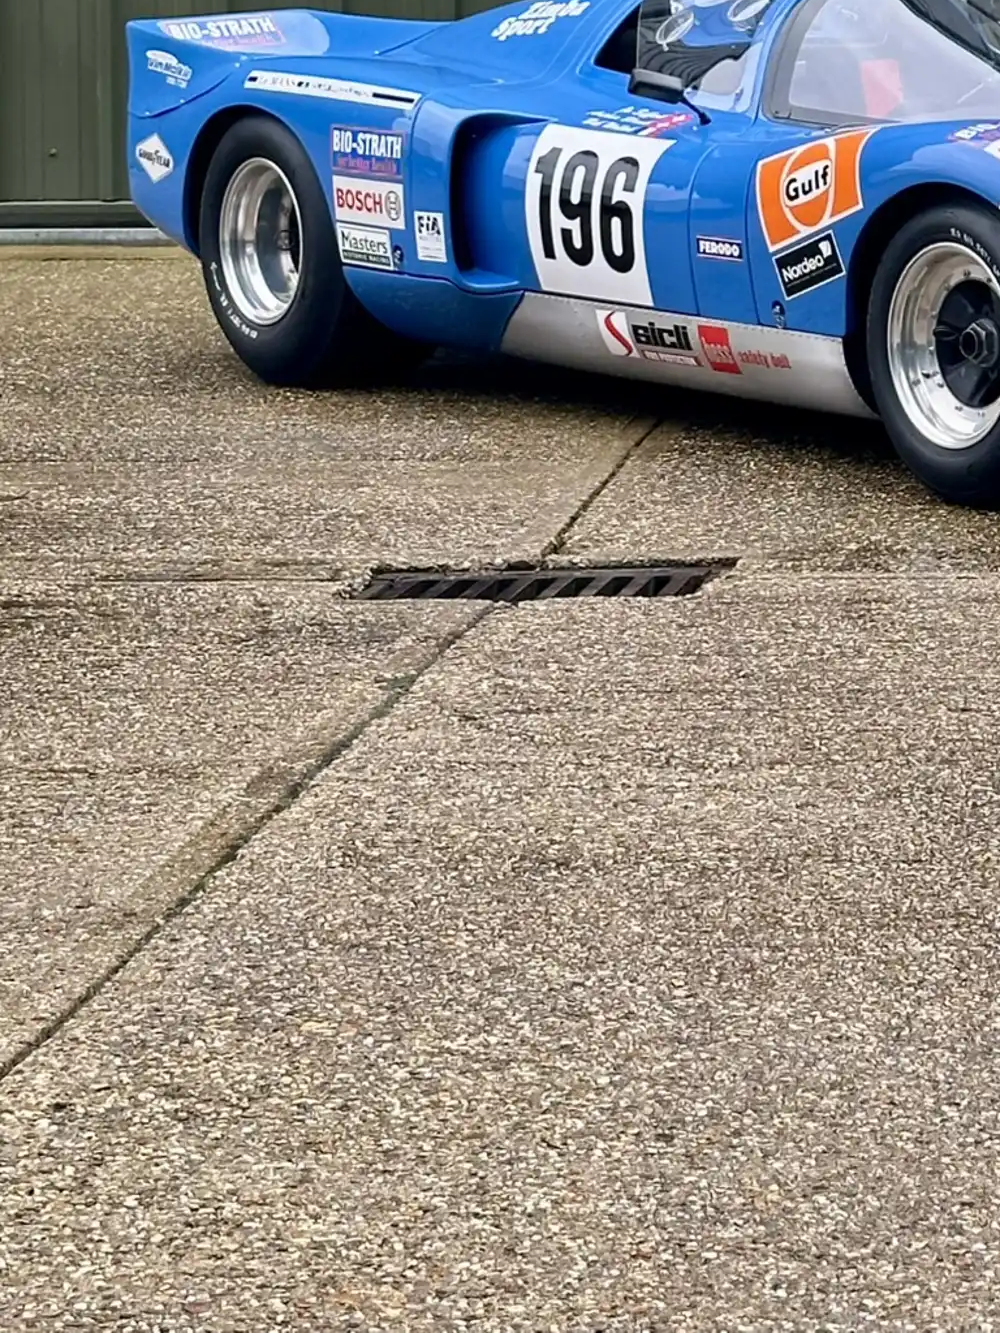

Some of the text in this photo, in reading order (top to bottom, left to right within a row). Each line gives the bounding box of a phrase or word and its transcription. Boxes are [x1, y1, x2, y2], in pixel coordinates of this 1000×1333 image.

[168, 16, 276, 40] BIO-STRATH
[491, 16, 556, 41] Sport
[332, 130, 402, 159] BIO-STRATH
[785, 164, 829, 202] Gulf
[336, 188, 383, 214] BOSCH
[534, 147, 640, 274] 196
[341, 229, 388, 254] Masters
[699, 239, 740, 257] FERODO
